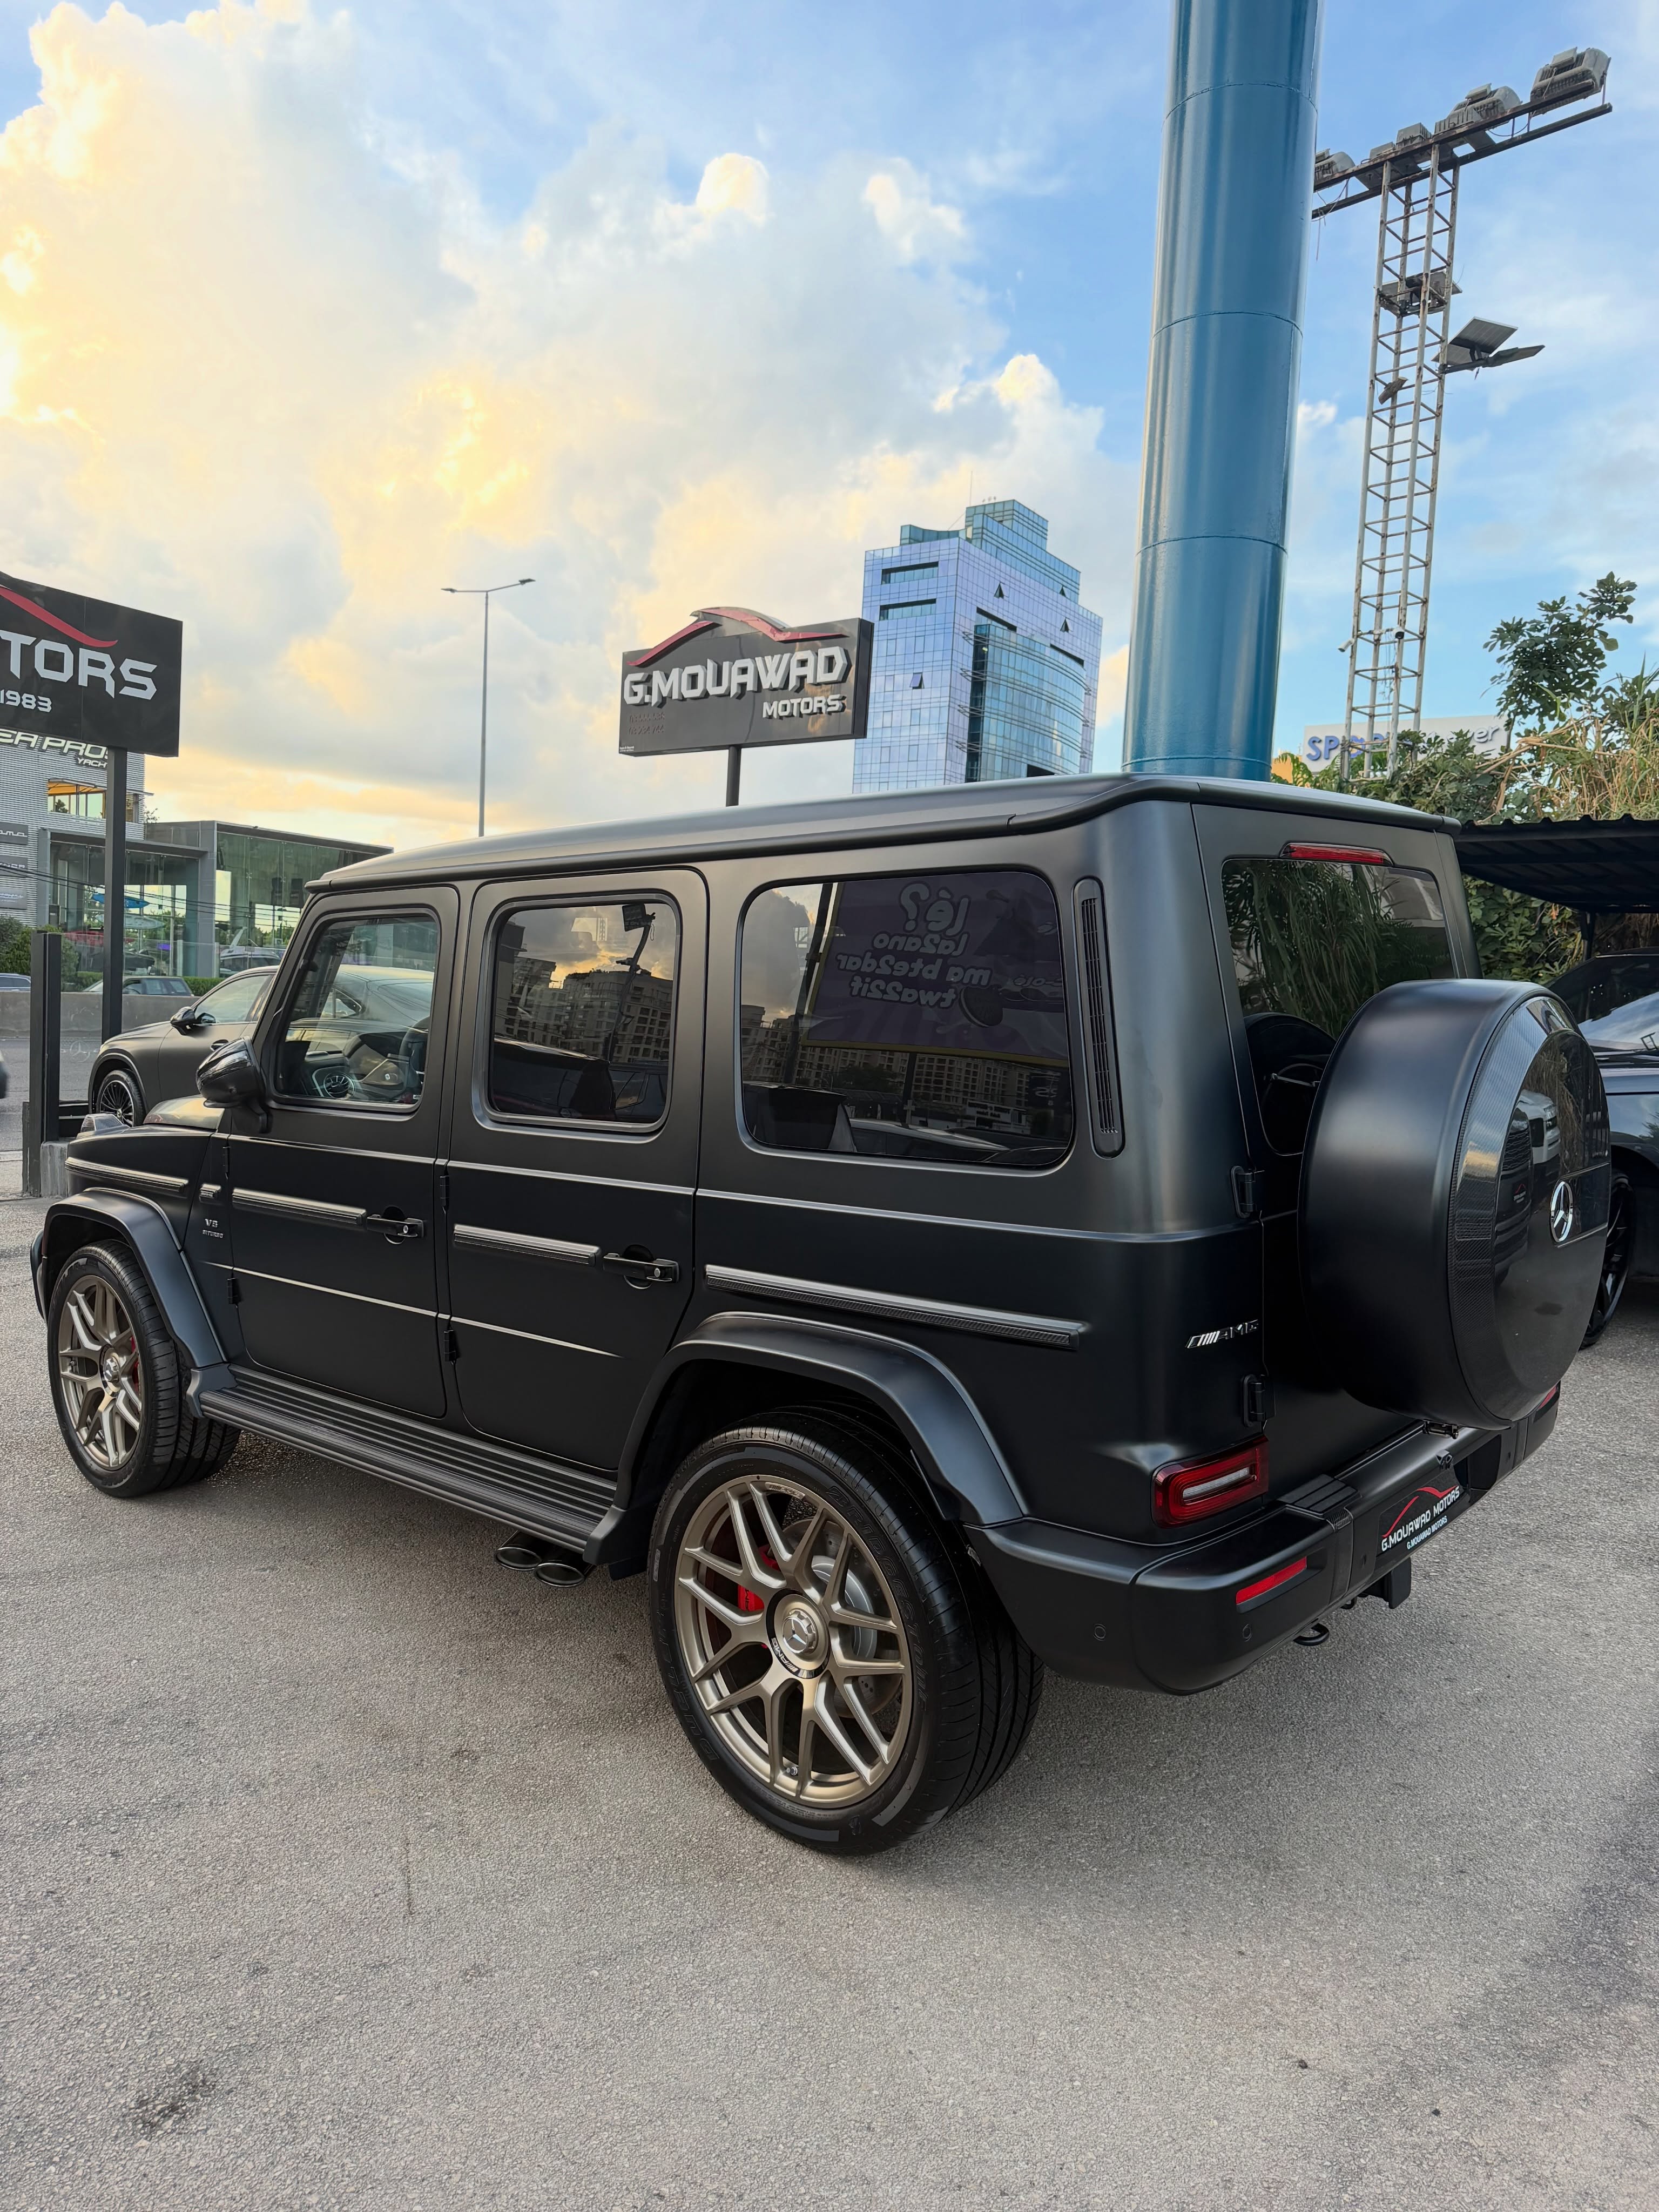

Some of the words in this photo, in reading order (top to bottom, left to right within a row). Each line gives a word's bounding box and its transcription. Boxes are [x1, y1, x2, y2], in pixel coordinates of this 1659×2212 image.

[0, 630, 157, 700] TORS
[624, 646, 849, 707] G.MOUAWAD
[0, 689, 52, 713] 1983
[763, 694, 845, 719] MOTORS
[42, 737, 108, 759] PRO
[77, 758, 107, 768] YACH
[203, 1230, 223, 1238] BITURBO
[205, 1218, 218, 1228] V8
[1381, 1509, 1431, 1552] G.MOUAWAD
[1433, 1486, 1460, 1516] MOTORS
[1407, 1527, 1431, 1549] G.MOUAWAD
[1431, 1515, 1447, 1533] MOTORS
[771, 1637, 788, 1662] AMG
